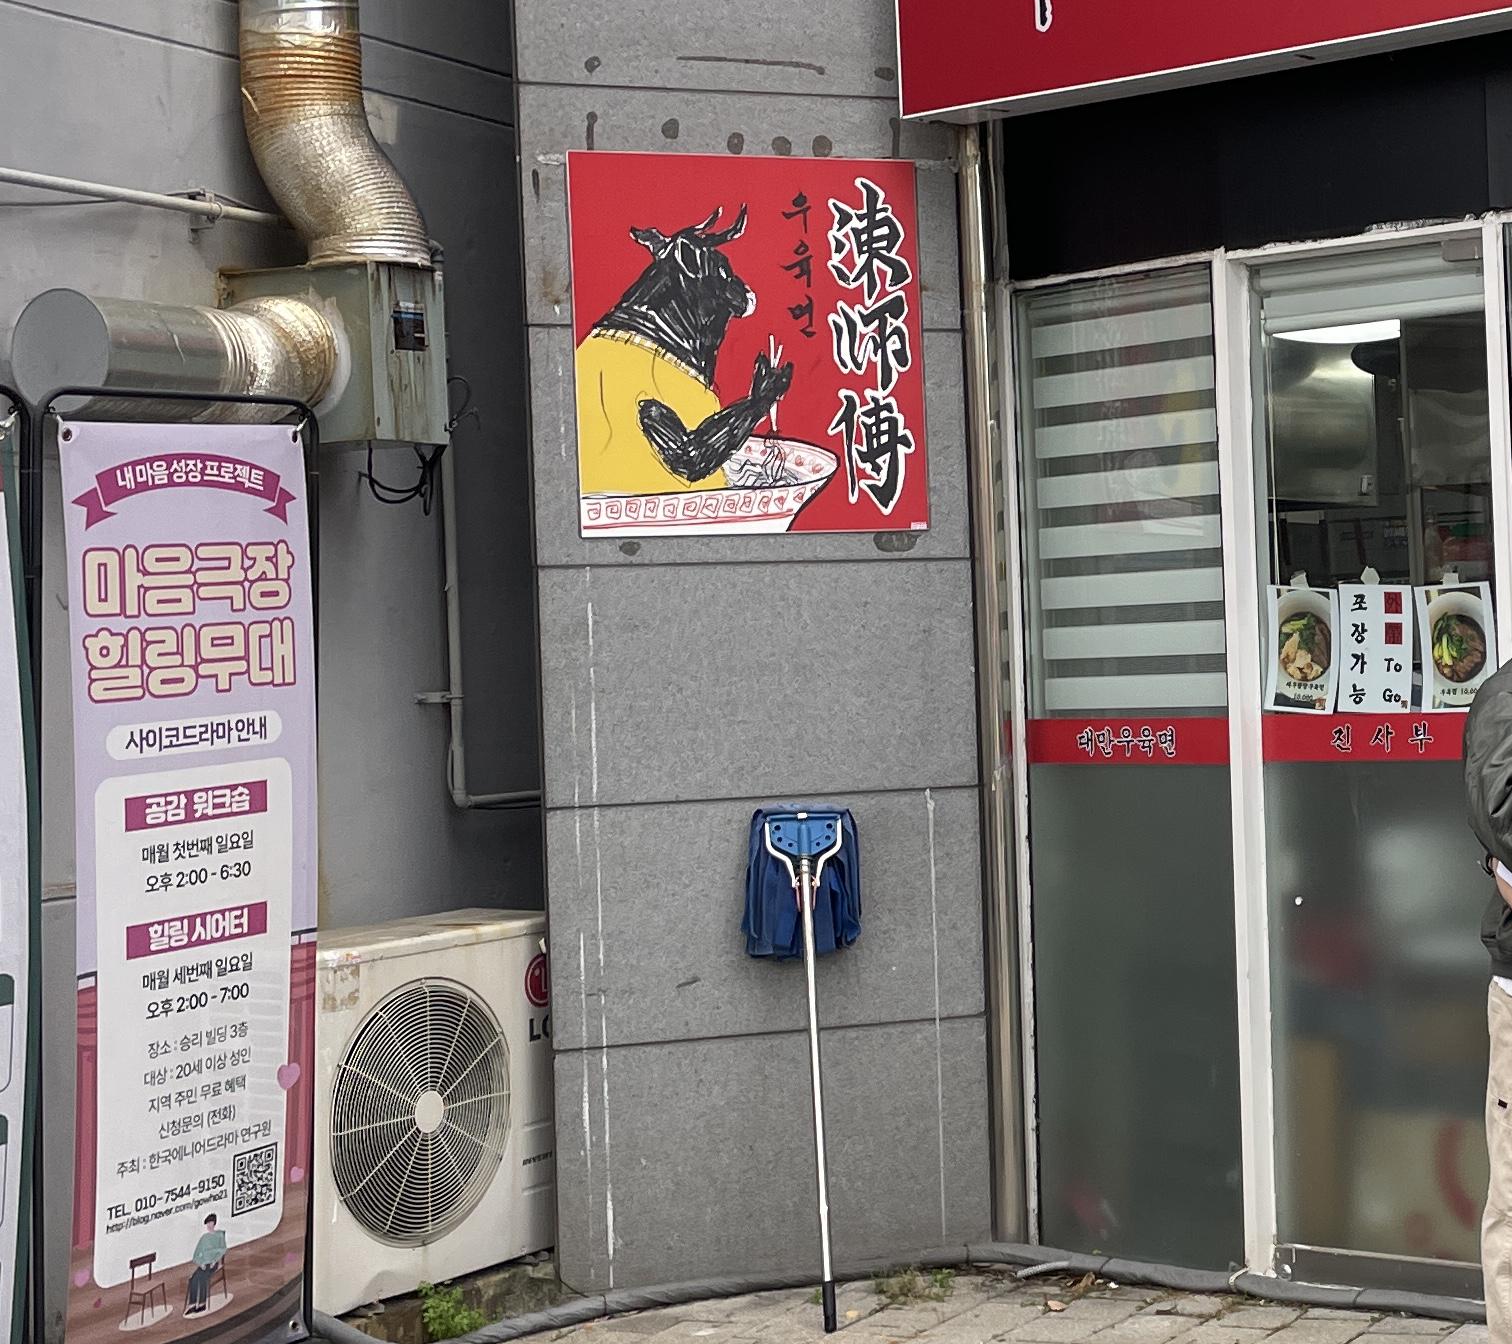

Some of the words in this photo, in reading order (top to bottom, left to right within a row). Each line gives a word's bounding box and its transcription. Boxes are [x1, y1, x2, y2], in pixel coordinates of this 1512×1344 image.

[116, 465, 136, 490] 내
[135, 460, 169, 486] 마음
[170, 459, 203, 483] 성장
[203, 460, 265, 491] 프로젝트
[82, 539, 295, 619] 마음극장
[82, 616, 297, 704] 힐링무대
[1384, 657, 1402, 673] To
[1382, 687, 1401, 703] Go
[125, 719, 233, 754] 사이코드라마
[235, 715, 268, 743] 안내
[1076, 726, 1176, 757] 대만우육면
[1330, 720, 1434, 753] 진사부
[145, 793, 187, 825] 공감
[192, 785, 250, 818] 워크숍
[142, 842, 169, 864] 매월
[172, 835, 213, 861] 첫번째
[215, 829, 254, 854] 일요일
[145, 872, 173, 893] 오후
[176, 867, 208, 888] 2:00
[220, 860, 251, 881] 6:30
[148, 918, 188, 952] 힐링
[190, 907, 248, 943] 시어터
[142, 968, 169, 991] 매월
[172, 960, 213, 985] 세번째
[215, 952, 253, 977] 일요일
[146, 998, 173, 1020] 오후
[176, 992, 208, 1013] 2:00
[219, 982, 250, 1004] 7:00
[148, 1039, 172, 1059] 장소
[179, 1030, 203, 1052] 승리
[205, 1024, 228, 1046] 빌딩
[229, 1021, 249, 1039] 3층
[143, 1066, 168, 1087] 대상
[175, 1058, 203, 1080] 20세
[205, 1051, 228, 1073] 이상
[229, 1045, 251, 1067] 성인
[148, 1093, 172, 1114] 지역
[174, 1086, 198, 1107] 주민
[200, 1081, 223, 1101] 무료
[224, 1073, 247, 1093] 혜택
[158, 1111, 204, 1140] 신청문의
[206, 1104, 236, 1128] (전화)
[116, 1155, 140, 1179] 주최
[149, 1130, 239, 1170] 한국에니어드라마
[240, 1119, 272, 1143] 연구원
[135, 1174, 225, 1213] 010-7544-9150
